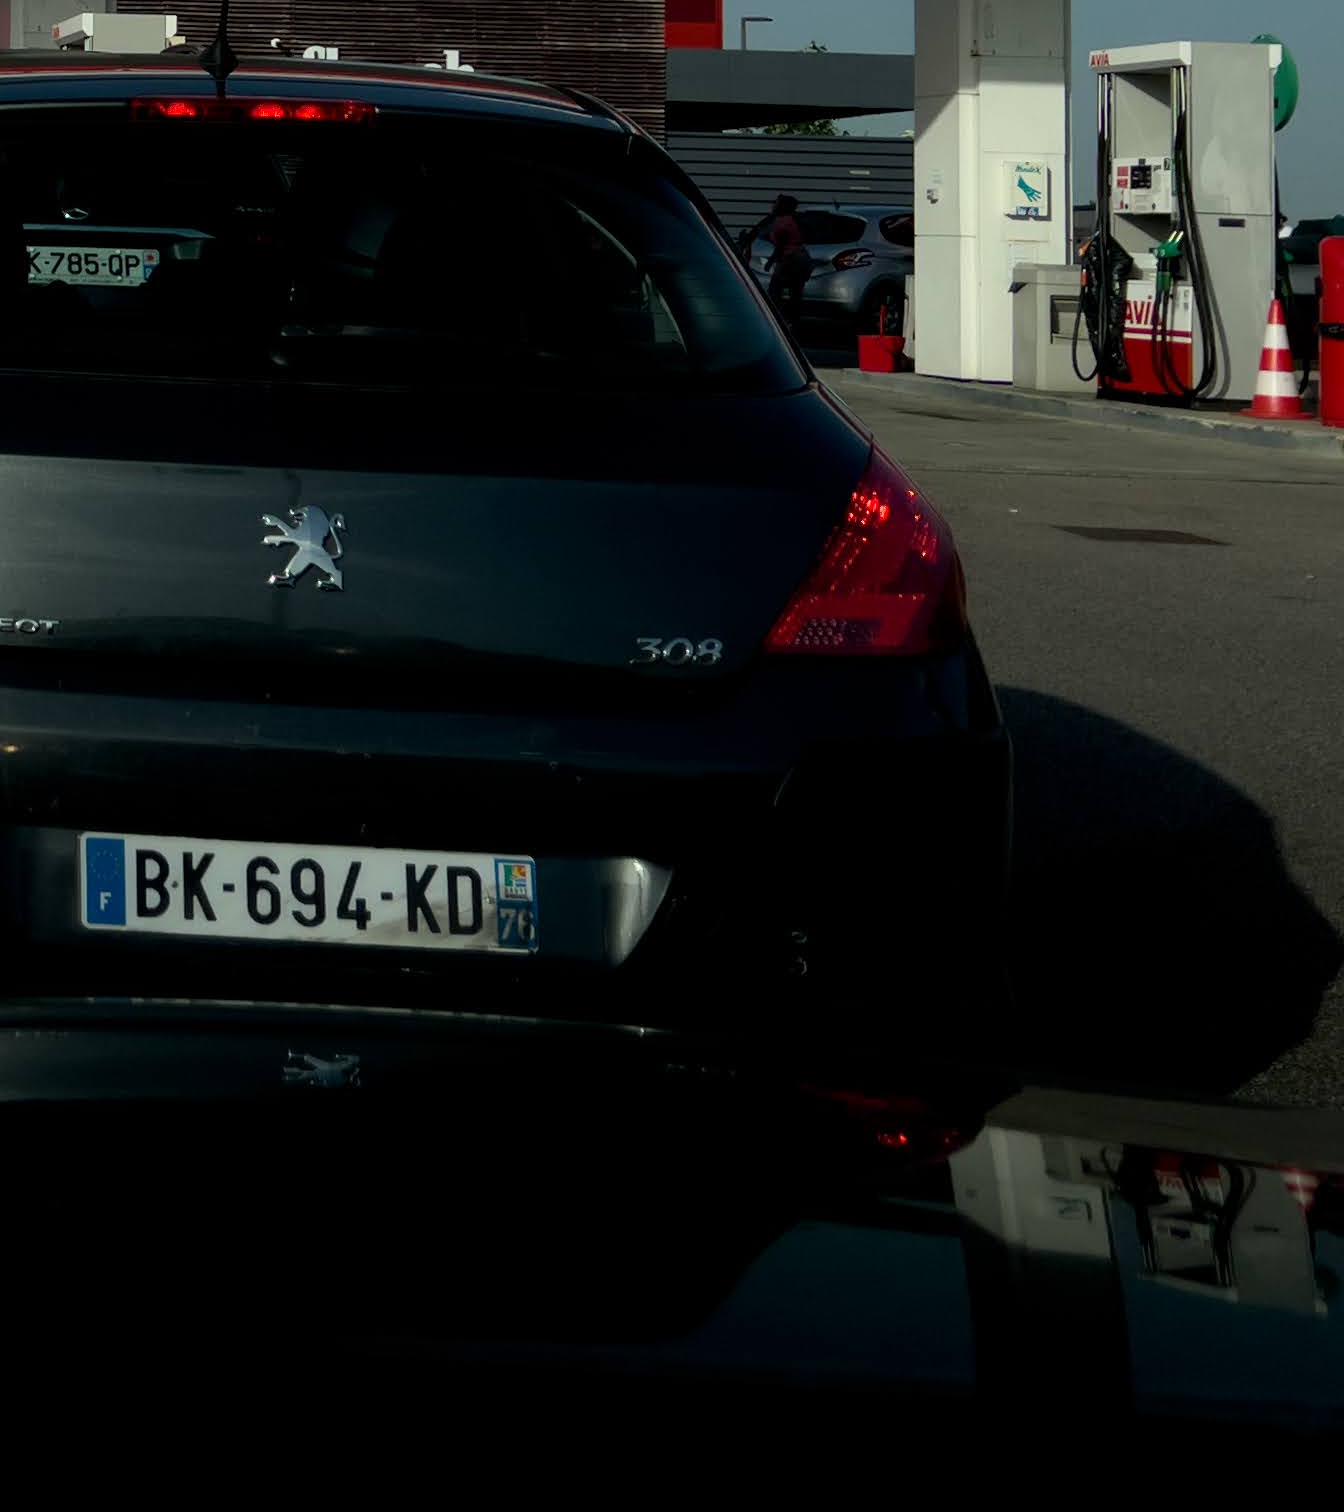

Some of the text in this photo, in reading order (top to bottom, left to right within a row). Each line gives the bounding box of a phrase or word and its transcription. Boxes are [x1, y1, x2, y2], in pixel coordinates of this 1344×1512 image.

[1090, 53, 1109, 66] AVIA
[629, 637, 723, 665] 308
[99, 848, 536, 942] F BK-694-KD 76
